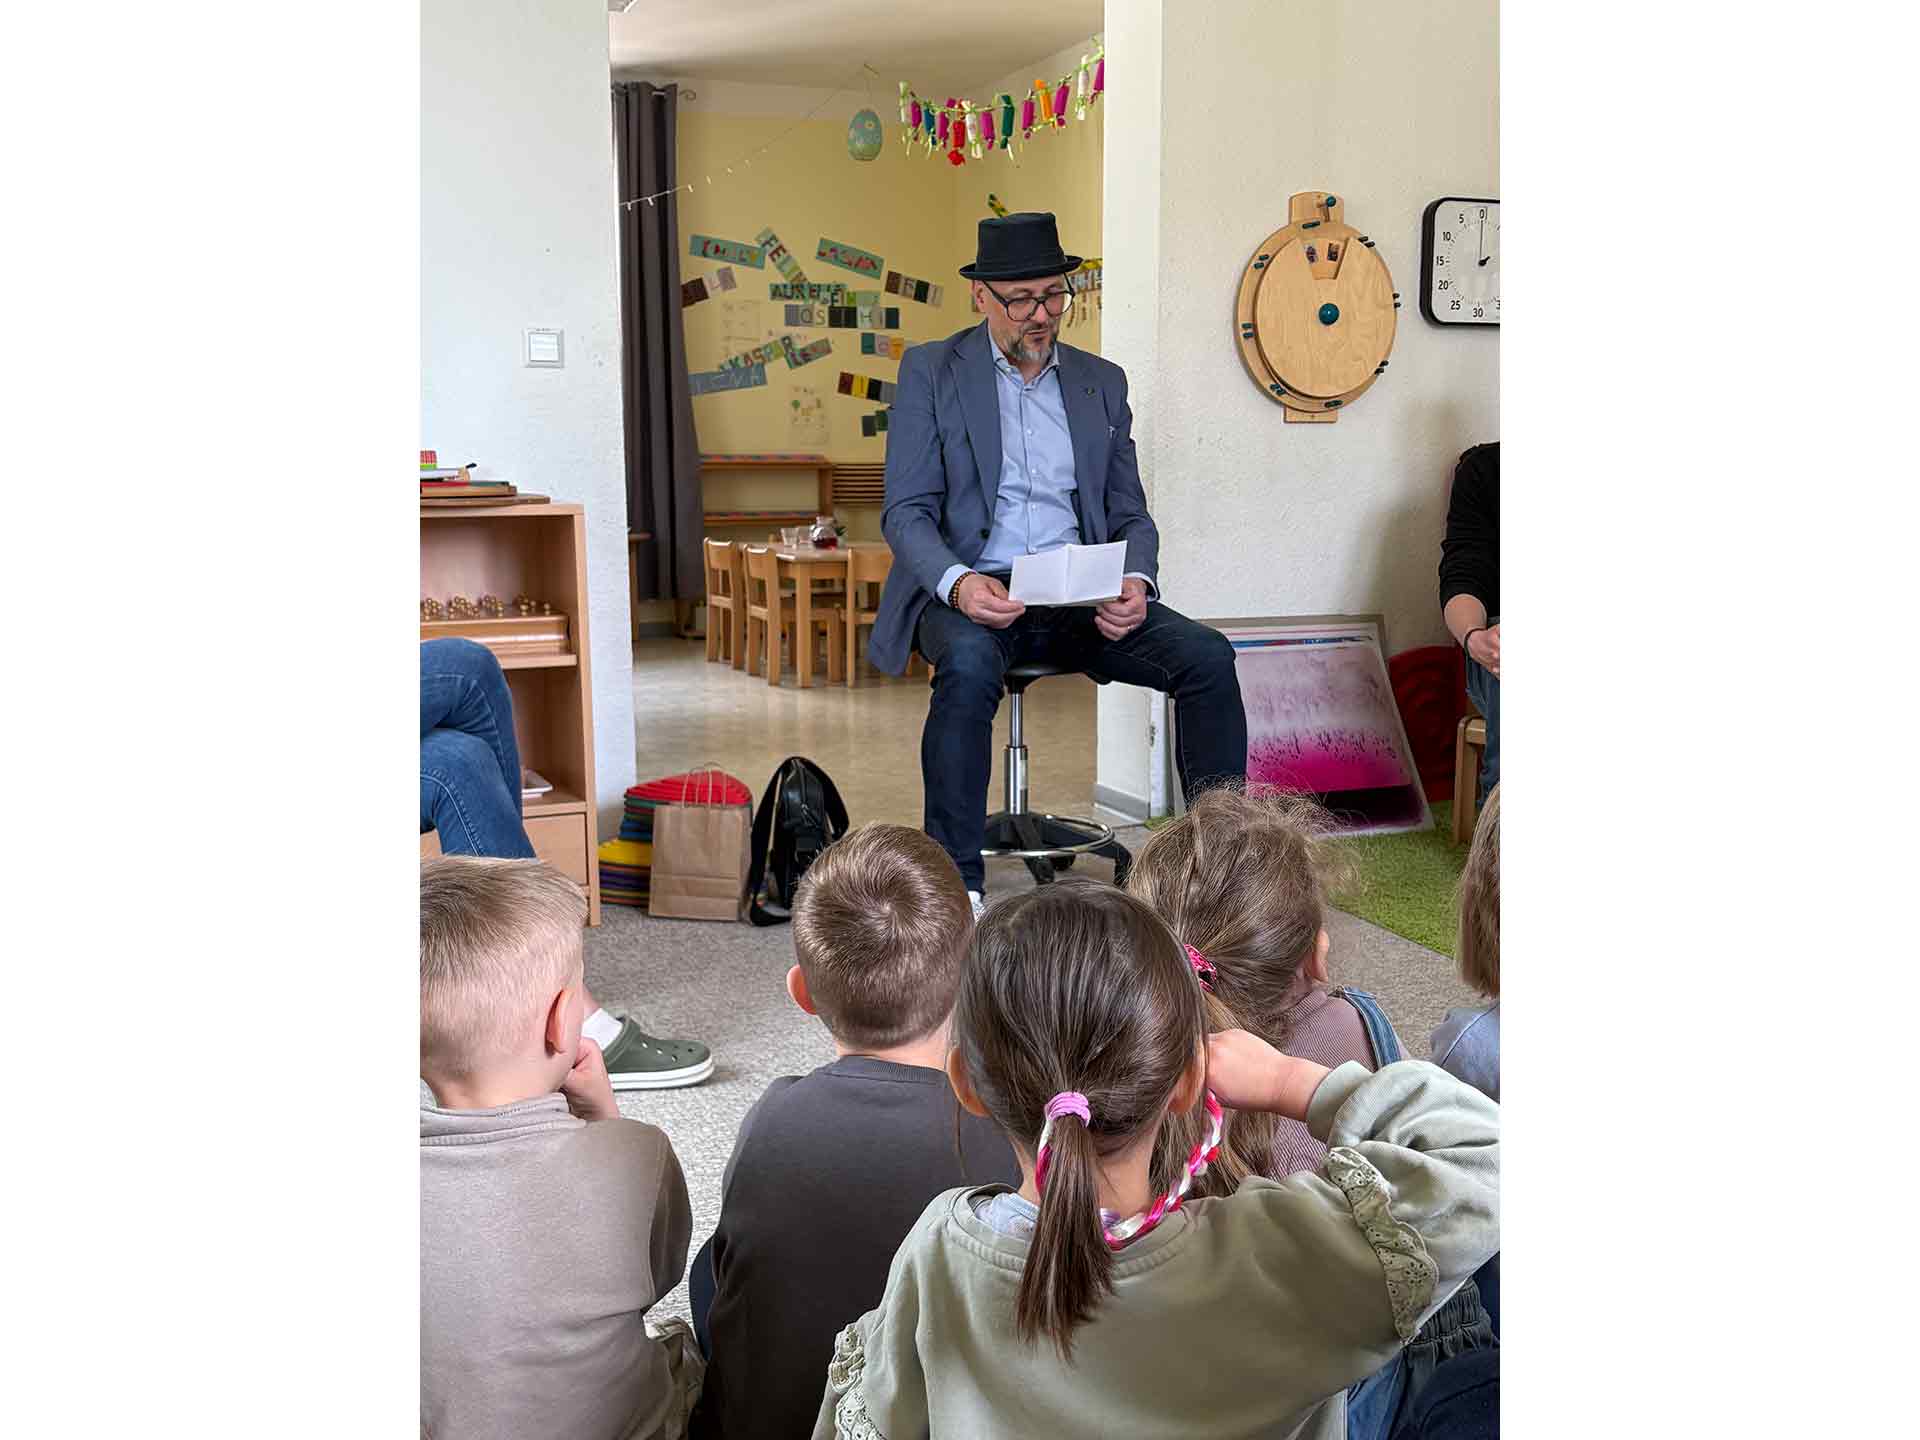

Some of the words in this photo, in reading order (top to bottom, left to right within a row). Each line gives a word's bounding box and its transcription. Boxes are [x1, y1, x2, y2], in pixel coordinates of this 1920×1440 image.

[1459, 214, 1464, 223] 5
[1443, 232, 1451, 241] 10
[1436, 256, 1444, 265] 15
[1438, 280, 1448, 290] 20
[1450, 301, 1460, 310] 25
[1473, 308, 1483, 317] 30
